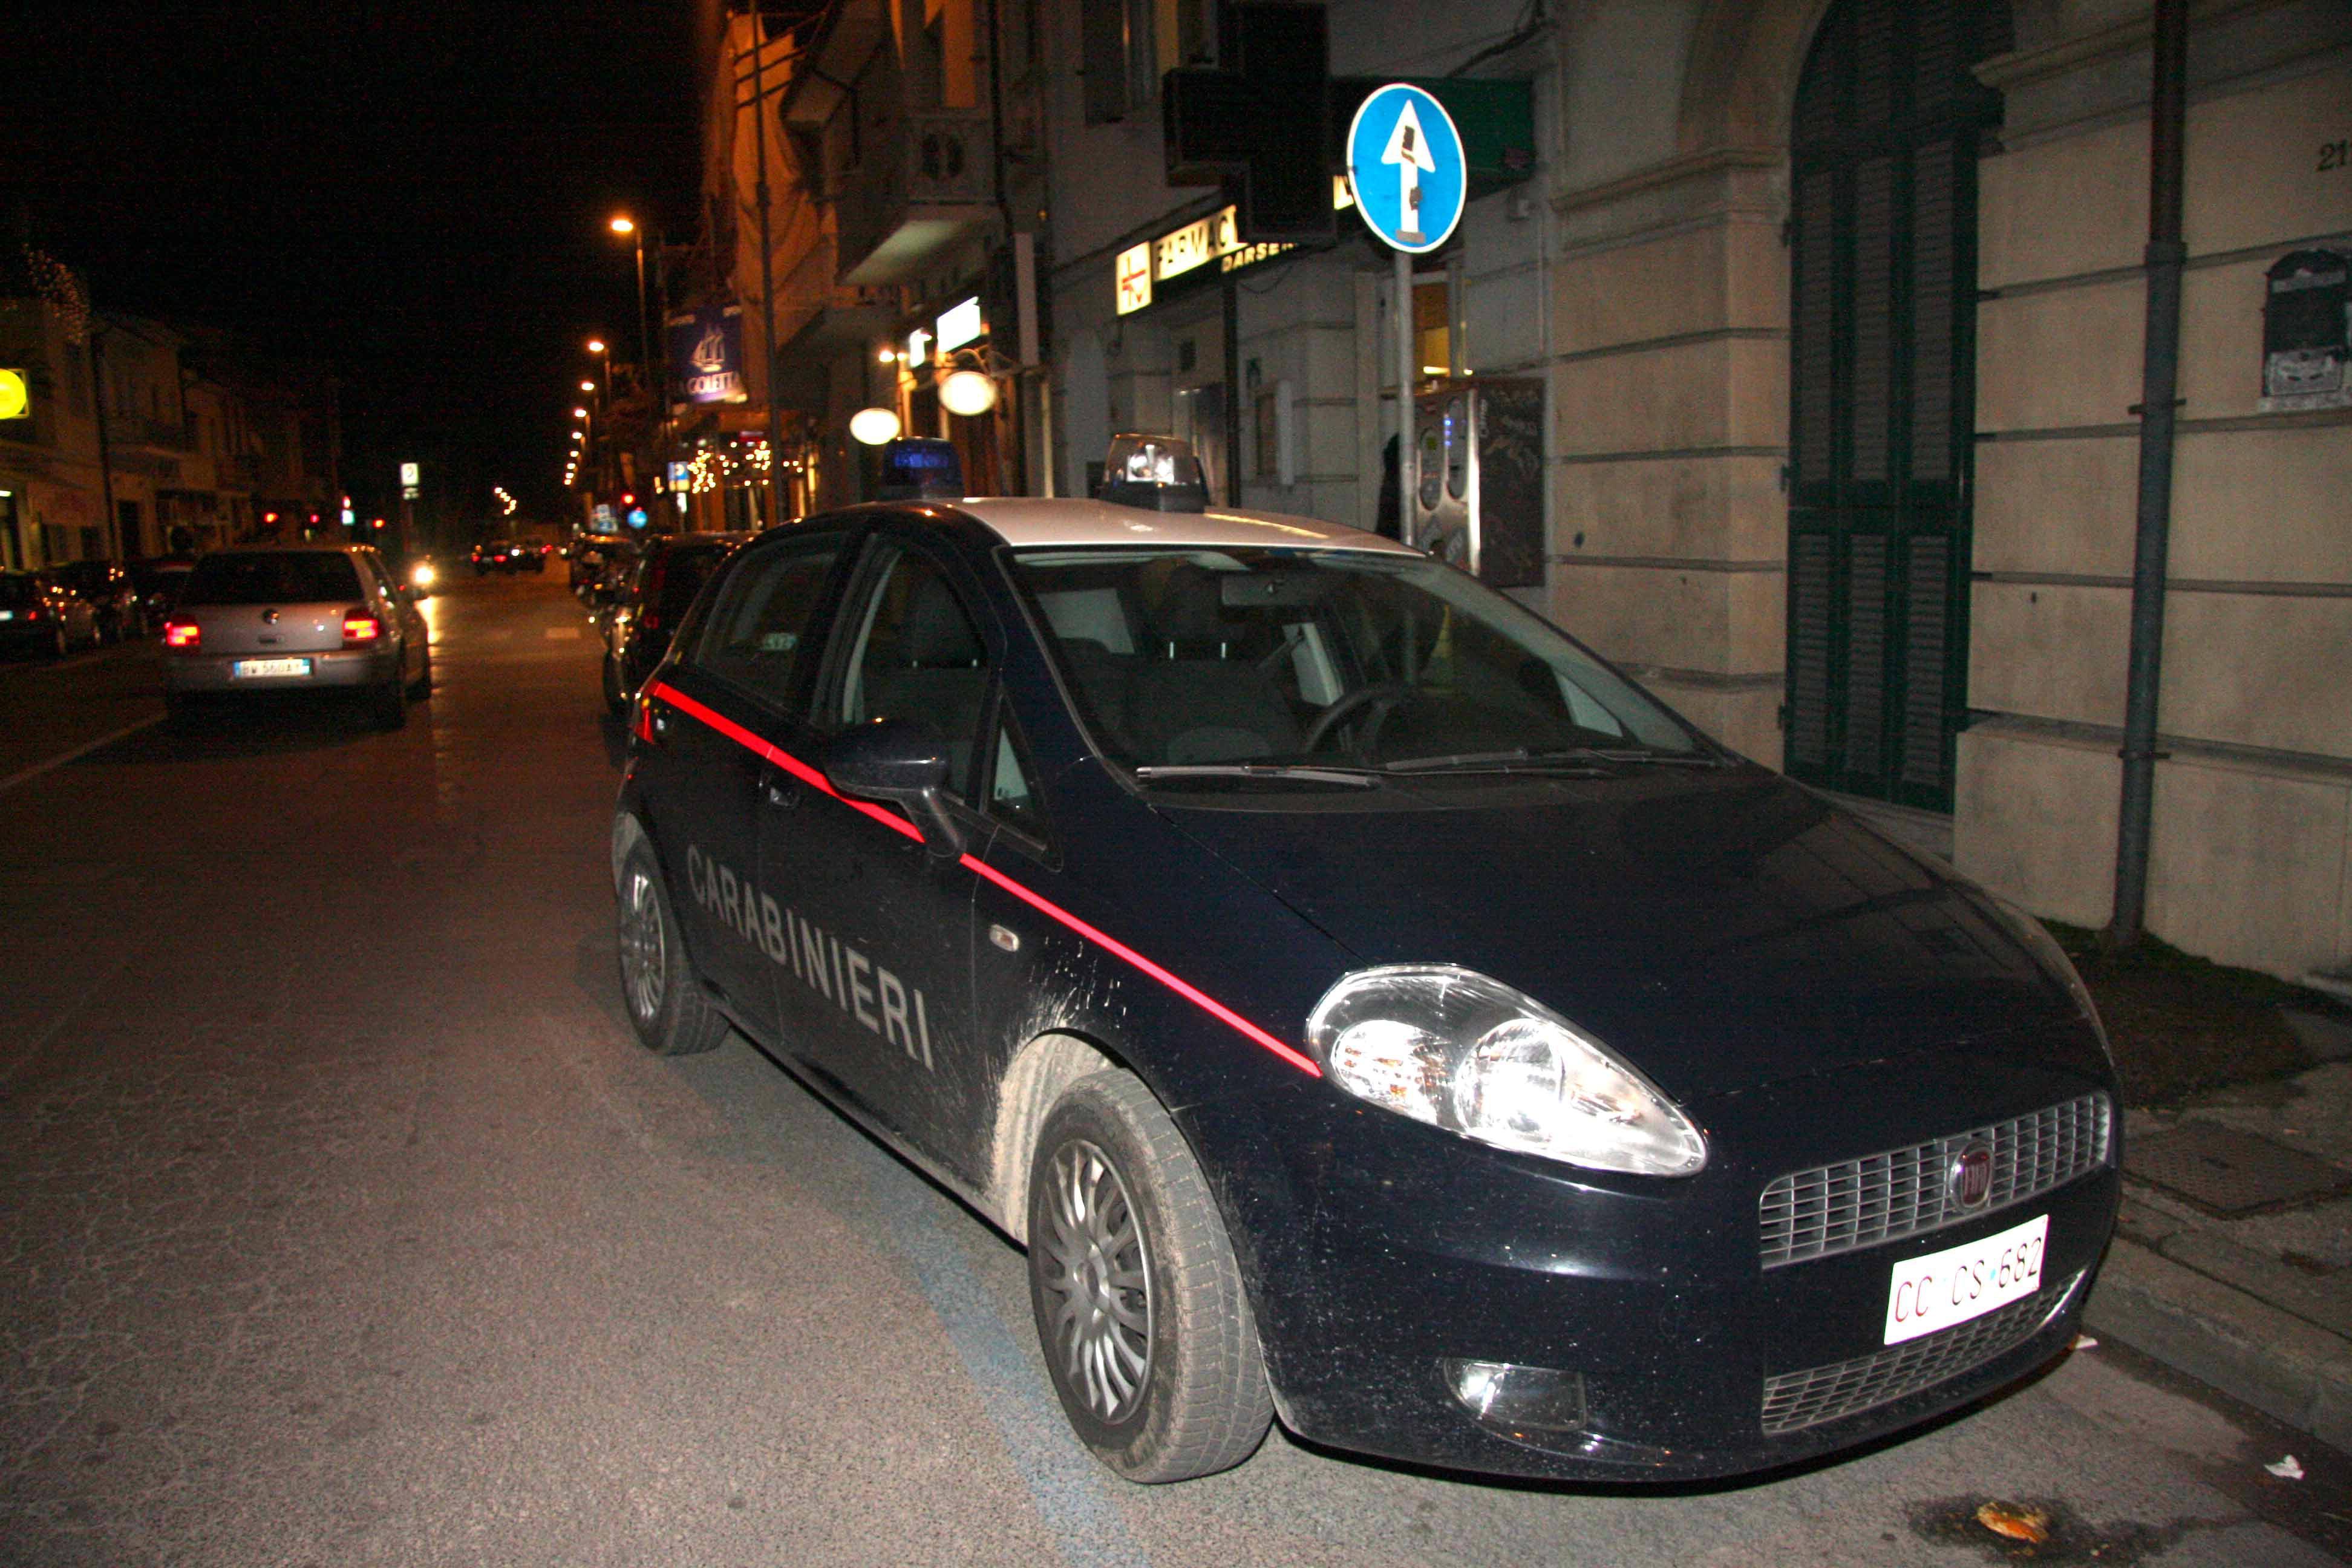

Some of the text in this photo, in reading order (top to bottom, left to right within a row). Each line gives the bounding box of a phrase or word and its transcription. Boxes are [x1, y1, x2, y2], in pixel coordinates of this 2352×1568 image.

[1152, 214, 1229, 273] FARMAC
[688, 844, 934, 1071] CARABINIERI
[1895, 1236, 2042, 1322] CC CS 682
